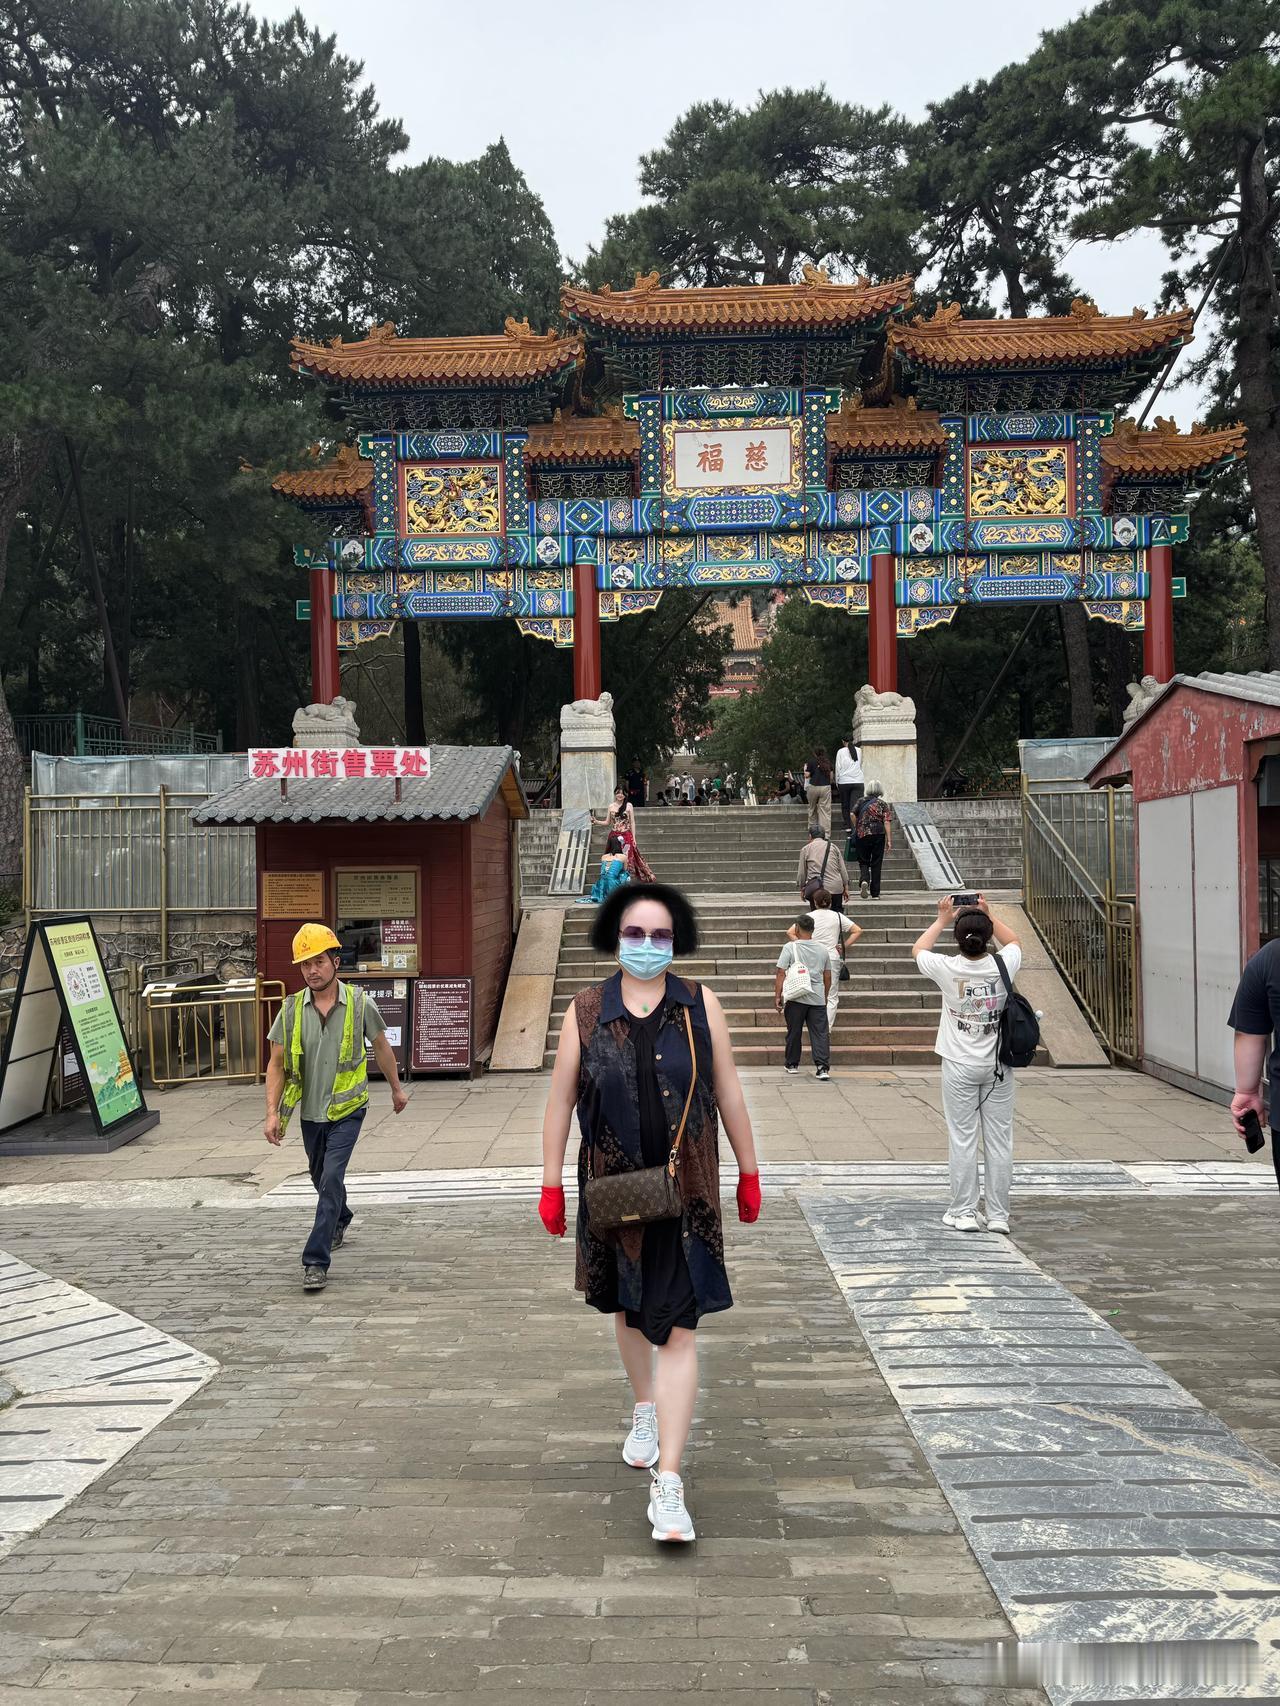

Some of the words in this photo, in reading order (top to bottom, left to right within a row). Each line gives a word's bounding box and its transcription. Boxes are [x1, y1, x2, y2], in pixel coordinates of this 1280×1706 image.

[251, 749, 428, 778] 苏州街售票处
[364, 990, 393, 998] 馨提示
